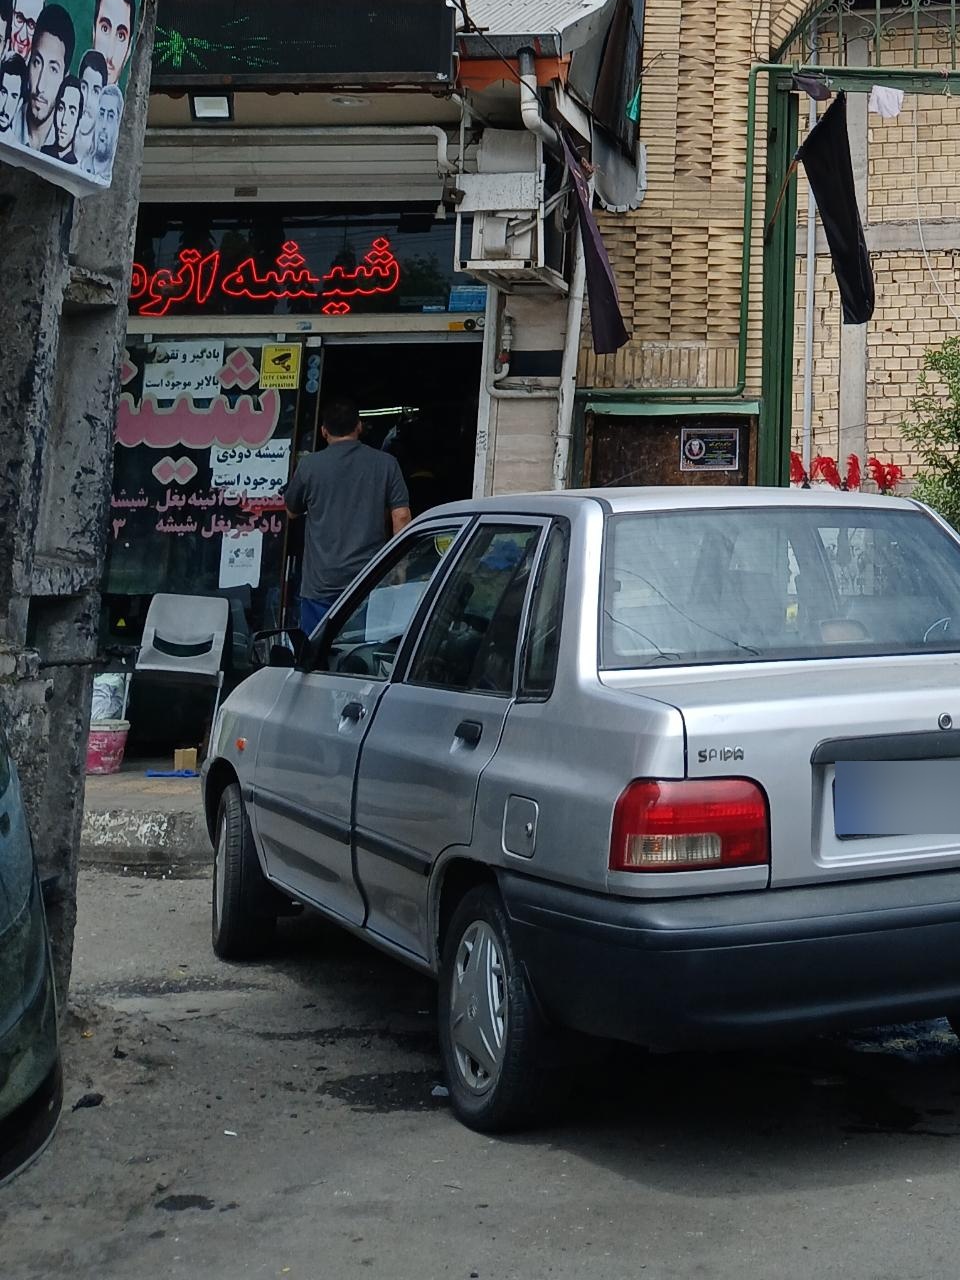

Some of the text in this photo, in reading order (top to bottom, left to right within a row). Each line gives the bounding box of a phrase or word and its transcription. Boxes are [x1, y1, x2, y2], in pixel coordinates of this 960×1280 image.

[221, 236, 401, 316] شیشه
[189, 347, 220, 364] بادگیر
[145, 377, 164, 388] است
[165, 377, 192, 391] موجود
[215, 445, 287, 466] شیشه دودی
[213, 472, 284, 491] موجود است
[155, 488, 187, 513] بغل
[155, 516, 198, 537] شیشه
